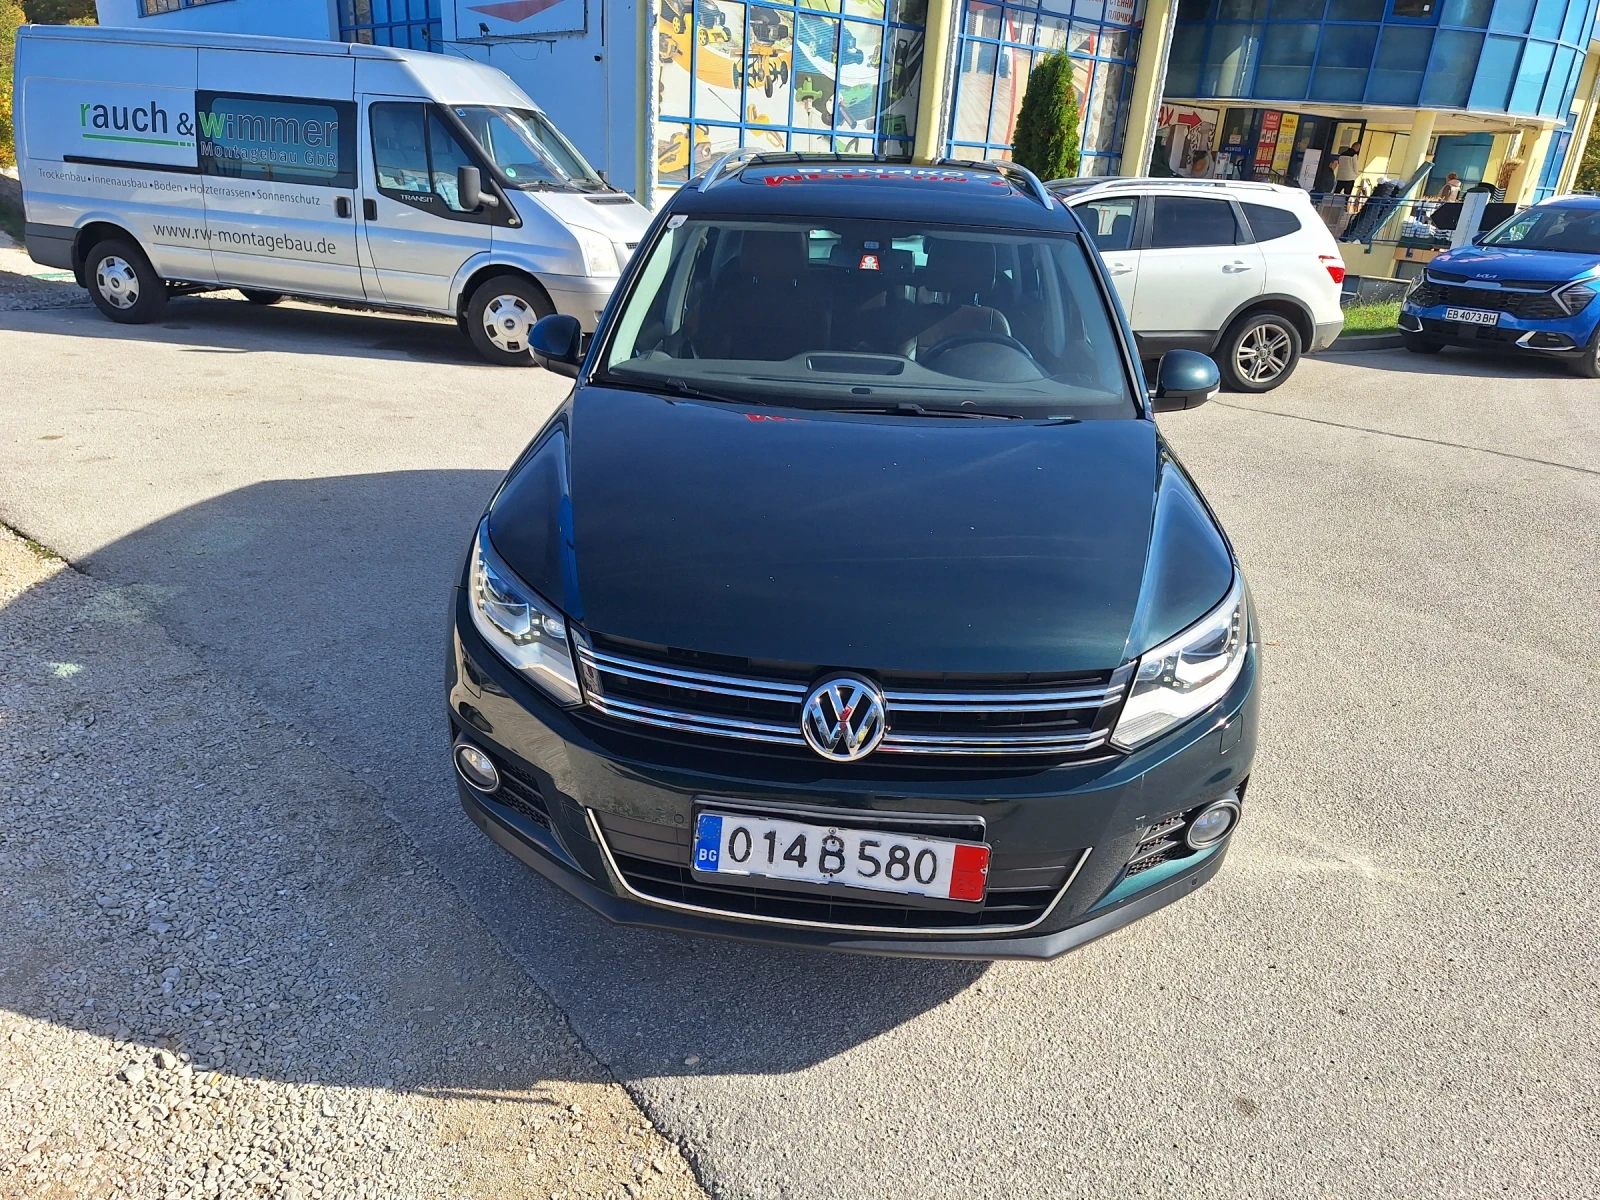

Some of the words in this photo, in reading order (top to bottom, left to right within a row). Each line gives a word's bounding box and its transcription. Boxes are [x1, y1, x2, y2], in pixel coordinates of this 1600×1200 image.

[1108, 10, 1132, 23] ПЛОЧКИ
[80, 101, 168, 134] rauch
[176, 112, 195, 136] &
[198, 111, 339, 148] wimmer
[200, 140, 298, 164] Montagebau
[304, 150, 337, 168] GbR
[38, 168, 87, 183] Trockenbau
[92, 174, 148, 189] Innenausbau
[154, 180, 182, 193] Boden
[189, 183, 251, 199] Holzterrassen
[257, 189, 321, 206] Sonnenschutz
[400, 194, 434, 203] TRANSIT
[152, 224, 337, 255] www.rw-montagebau.de
[1447, 309, 1459, 319] EB
[1460, 311, 1481, 322] 4073
[1482, 313, 1496, 324] BH
[699, 848, 717, 862] BG
